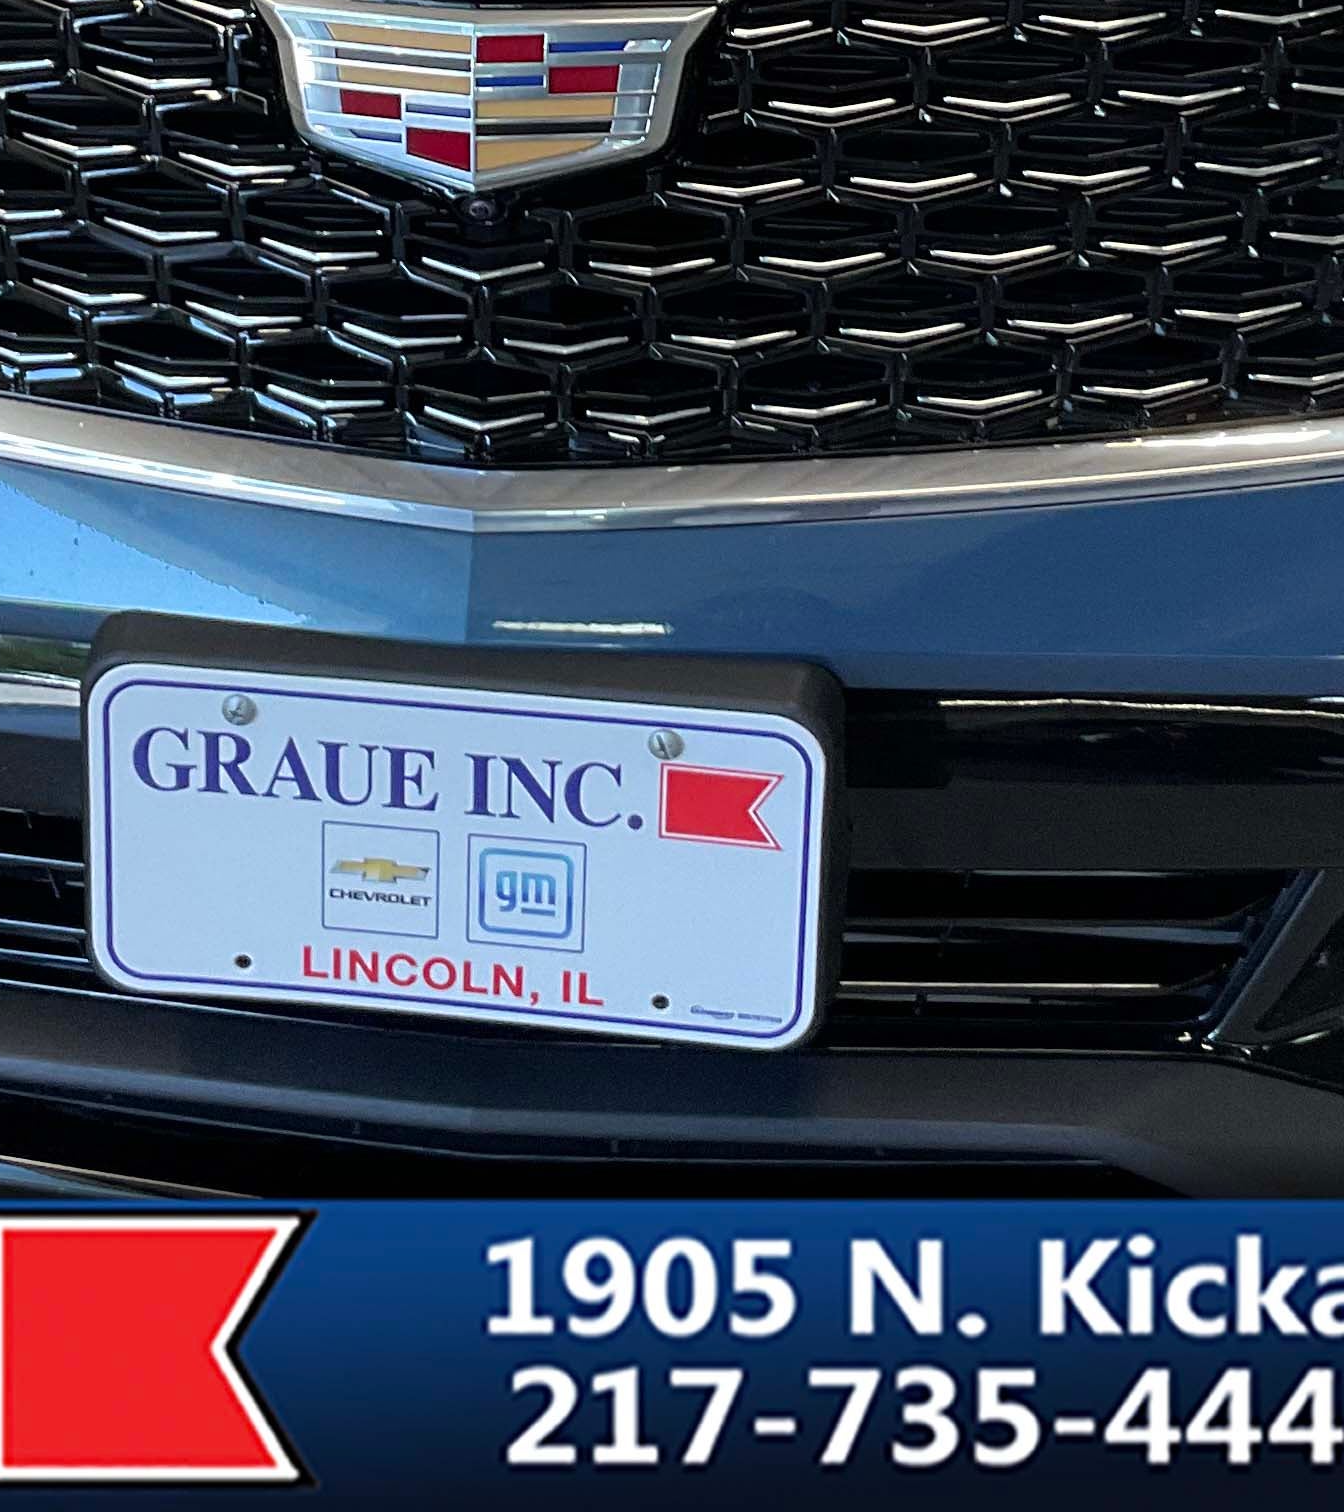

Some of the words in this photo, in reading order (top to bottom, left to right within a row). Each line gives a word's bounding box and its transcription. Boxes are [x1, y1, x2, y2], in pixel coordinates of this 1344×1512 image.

[132, 726, 440, 812] GRAUE
[463, 752, 644, 831] INC.
[328, 887, 432, 907] CHEVROLET
[495, 870, 557, 913] gm
[303, 946, 540, 1005] LINCOLN,
[562, 971, 603, 1007] IL
